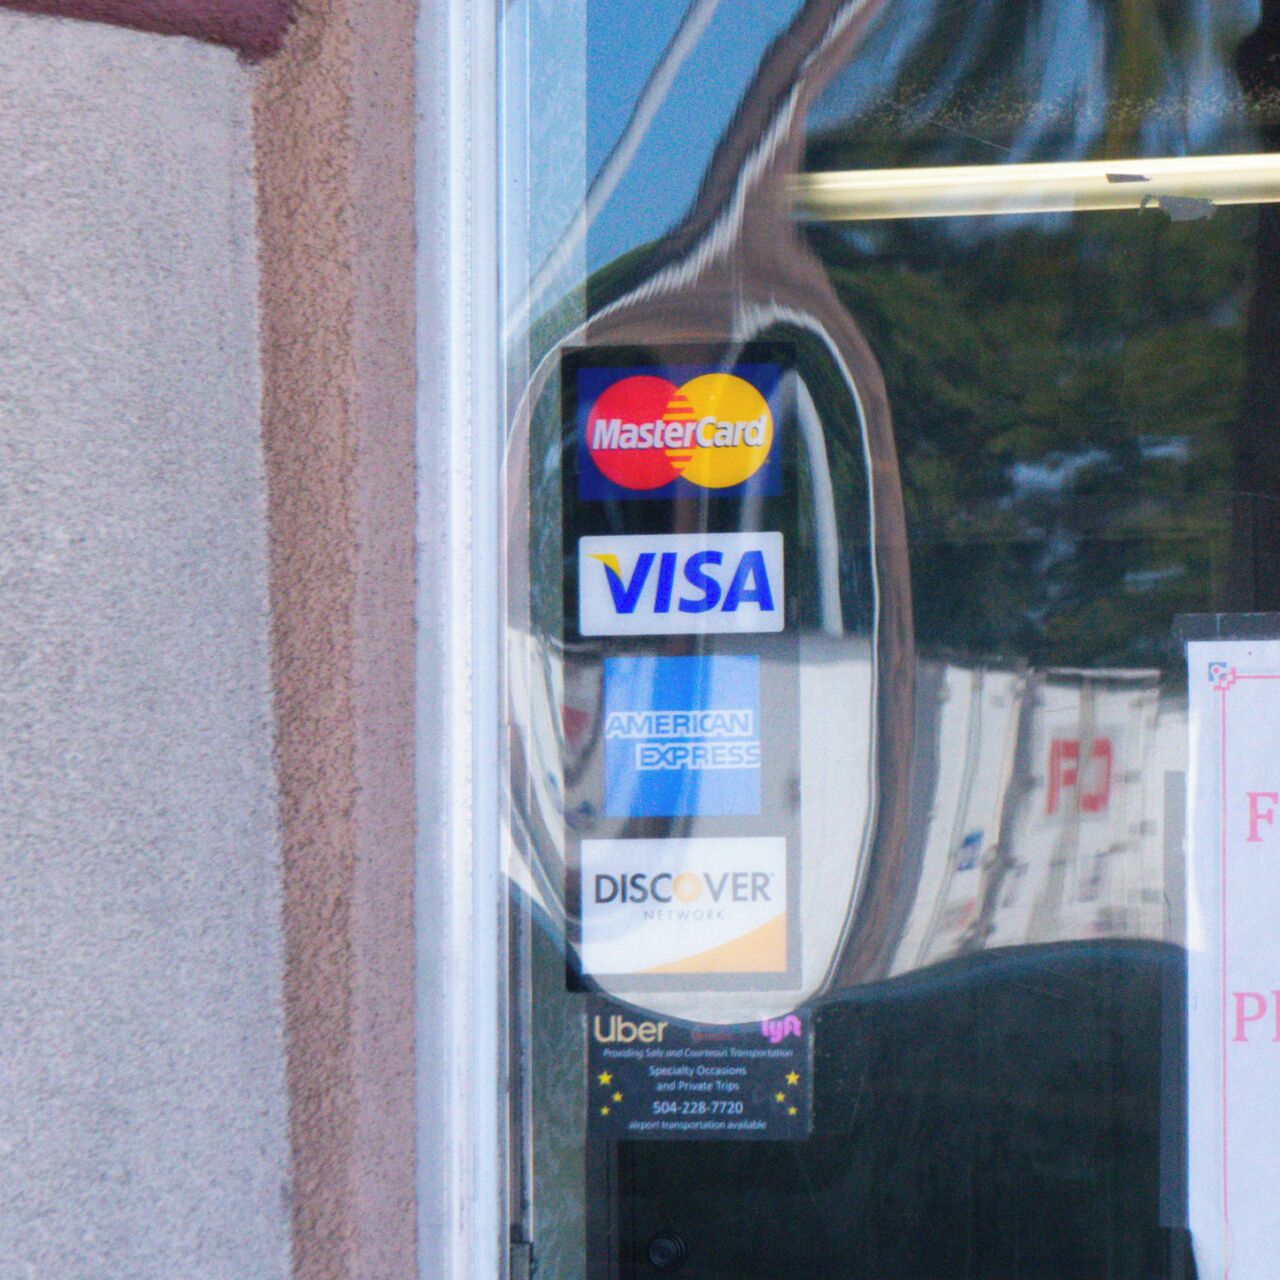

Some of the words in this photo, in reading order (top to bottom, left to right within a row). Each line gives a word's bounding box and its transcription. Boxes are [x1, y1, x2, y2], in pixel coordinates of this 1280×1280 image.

[591, 415, 768, 451] MasterCard
[586, 550, 775, 614] VISA
[605, 710, 752, 738] AMERICAN
[638, 742, 761, 769] EXPRESS
[594, 871, 772, 904] DISCOVER
[643, 909, 725, 921] NETWORK
[594, 1015, 669, 1043] Uber
[603, 1048, 644, 1060] Providing
[645, 1048, 664, 1058] Safe
[665, 1048, 683, 1057] and
[684, 1048, 728, 1058] Courteous
[729, 1048, 794, 1058] Transportation
[649, 1066, 694, 1077] Specialty
[697, 1066, 747, 1076] Occasions
[656, 1081, 676, 1090] and
[678, 1081, 713, 1090] Private
[715, 1081, 740, 1092] Trips
[652, 1101, 744, 1114] 504-228-7720
[629, 1121, 660, 1131] airport
[661, 1121, 726, 1131] transportation
[727, 1121, 767, 1130] available
